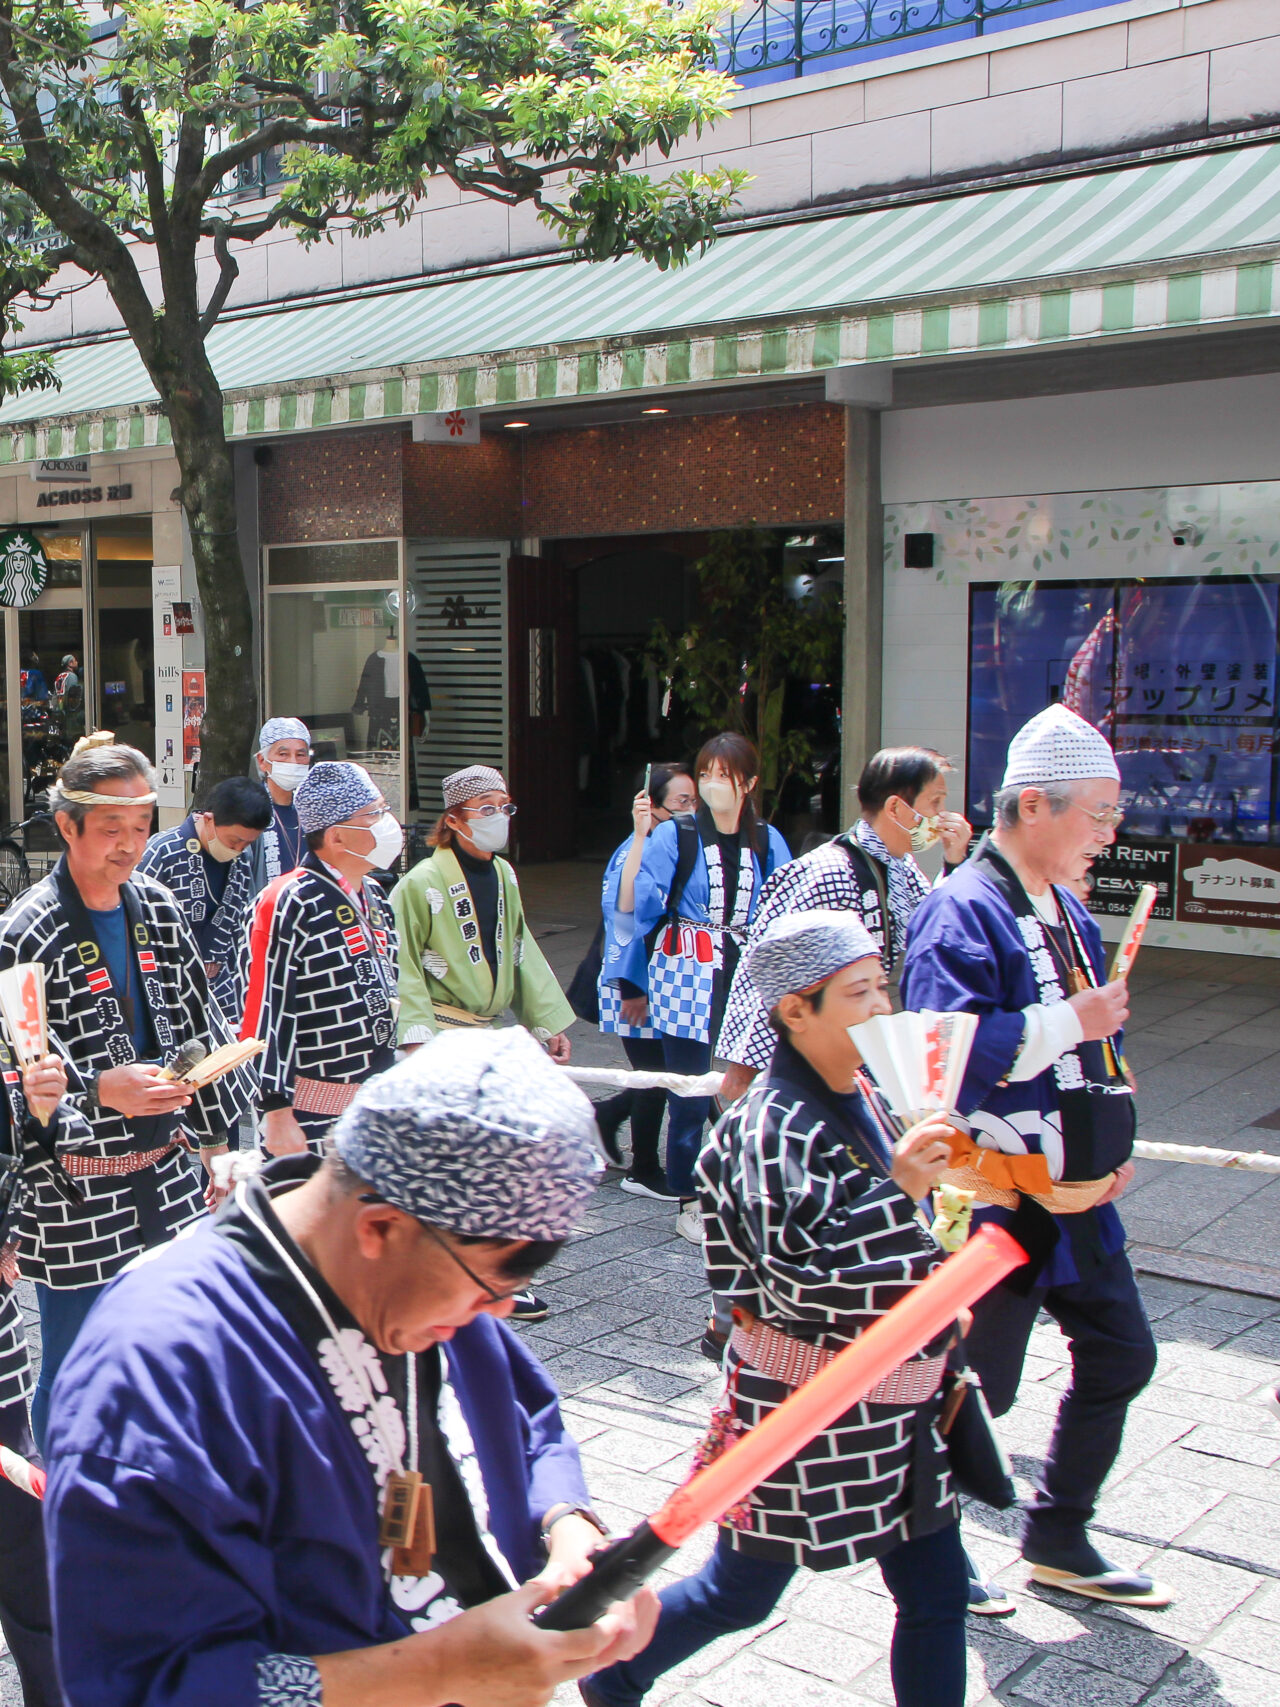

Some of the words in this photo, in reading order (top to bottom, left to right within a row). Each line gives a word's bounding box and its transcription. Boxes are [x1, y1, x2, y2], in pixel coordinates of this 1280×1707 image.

[37, 487, 102, 508] ACROSS
[158, 666, 180, 678] hill's
[1116, 845, 1170, 863] RENT
[1199, 873, 1276, 889] テナント募集
